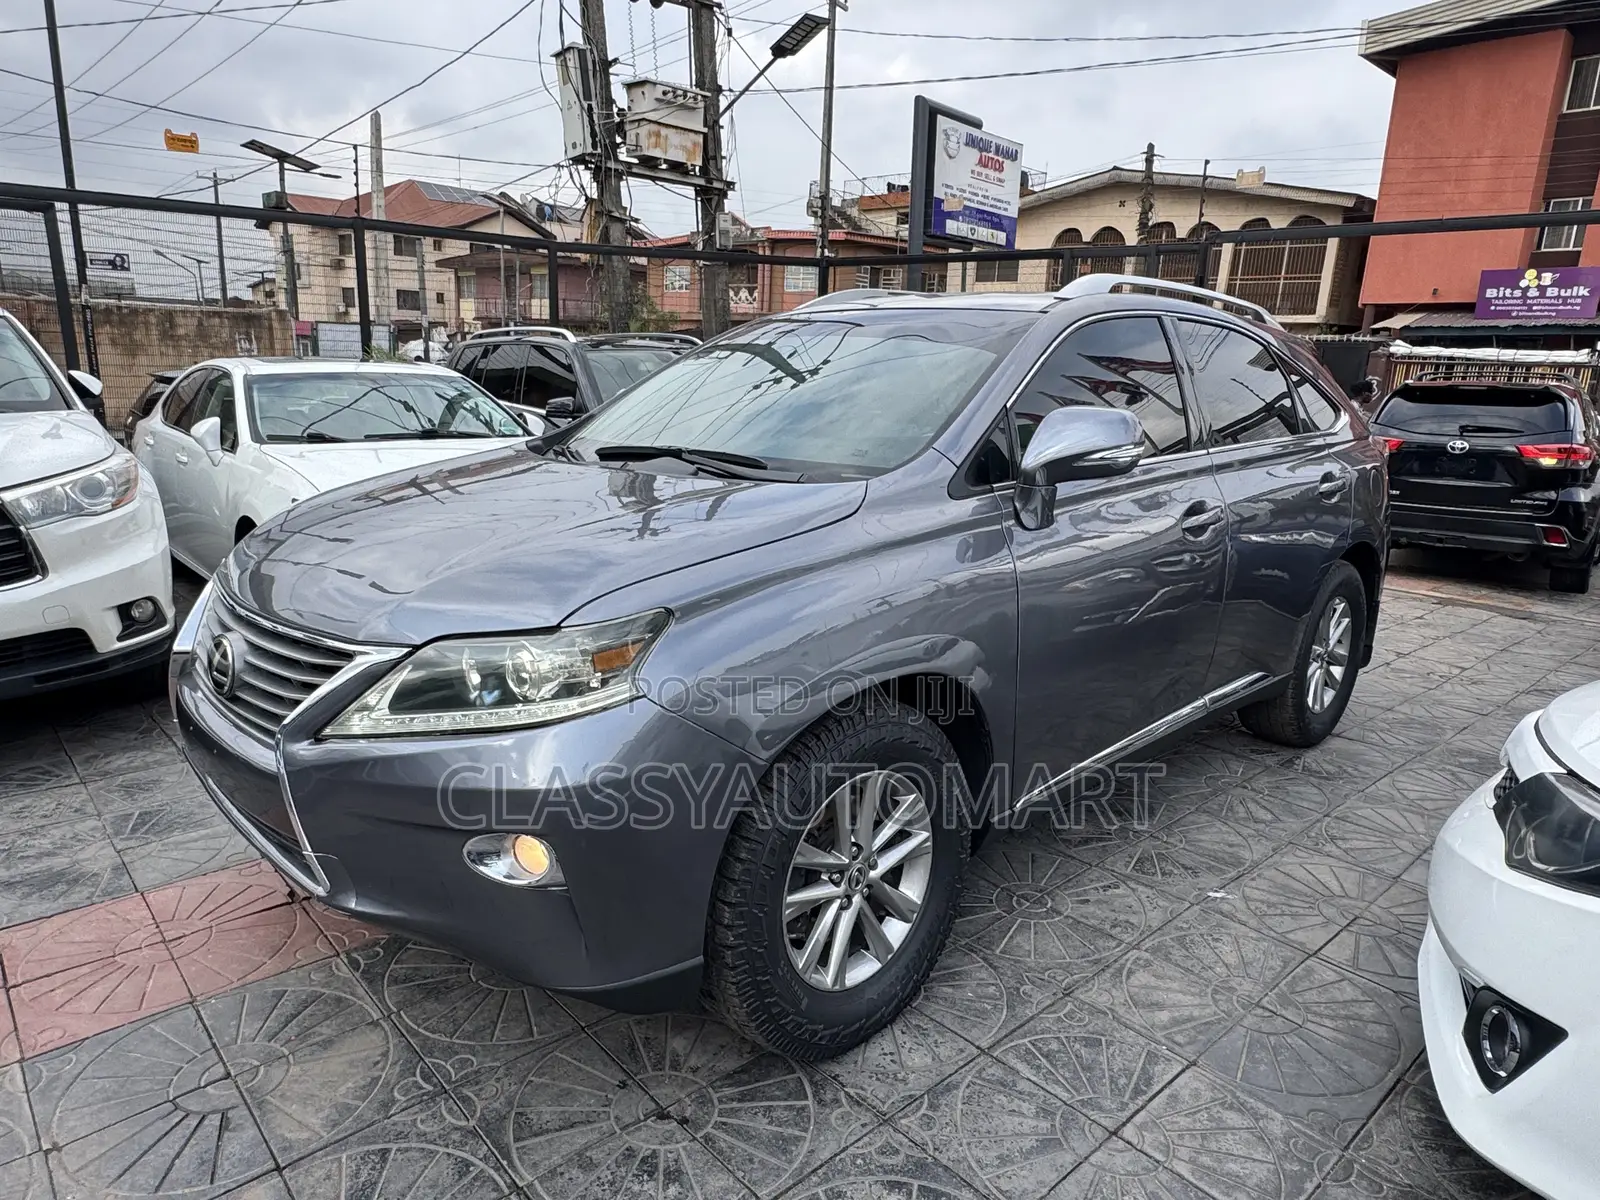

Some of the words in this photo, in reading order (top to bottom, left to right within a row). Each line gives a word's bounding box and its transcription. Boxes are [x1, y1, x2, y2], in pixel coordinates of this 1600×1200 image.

[963, 132, 993, 154] UNIQUE
[976, 153, 1005, 173] AUTOS
[1485, 287, 1522, 298] Bits
[1526, 288, 1540, 298] &
[1545, 286, 1592, 297] Bulk
